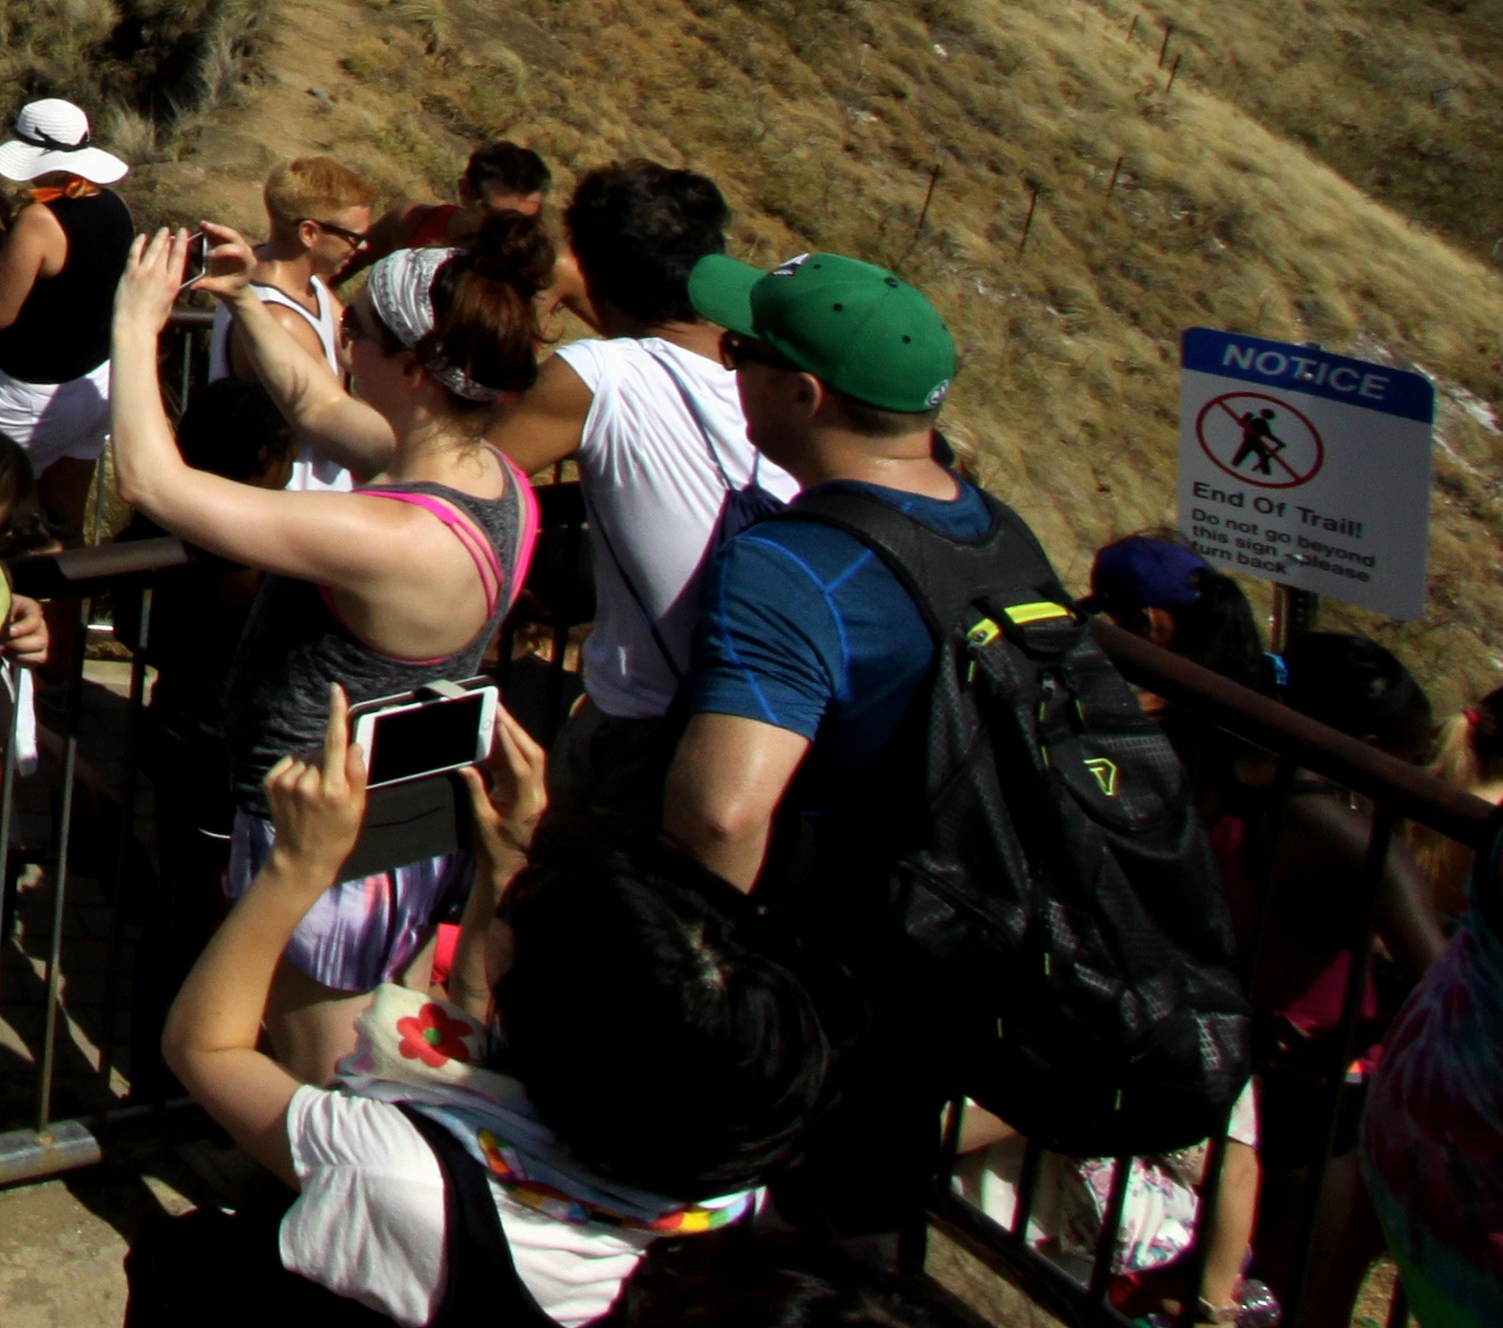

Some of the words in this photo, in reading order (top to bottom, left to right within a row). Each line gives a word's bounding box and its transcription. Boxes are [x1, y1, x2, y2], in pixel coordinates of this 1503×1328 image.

[1222, 343, 1390, 400] NOTICE
[1192, 508, 1220, 525] Do
[1225, 518, 1259, 535] not
[1265, 529, 1292, 543] go
[1297, 534, 1376, 567] beyond
[1193, 481, 1244, 507] End
[1253, 496, 1288, 517] Of
[1296, 506, 1363, 539] Trail!
[1192, 525, 1229, 544] this
[1235, 536, 1278, 556] sign
[1298, 554, 1371, 583] please
[1192, 541, 1232, 560] turn
[1236, 550, 1288, 575] back
